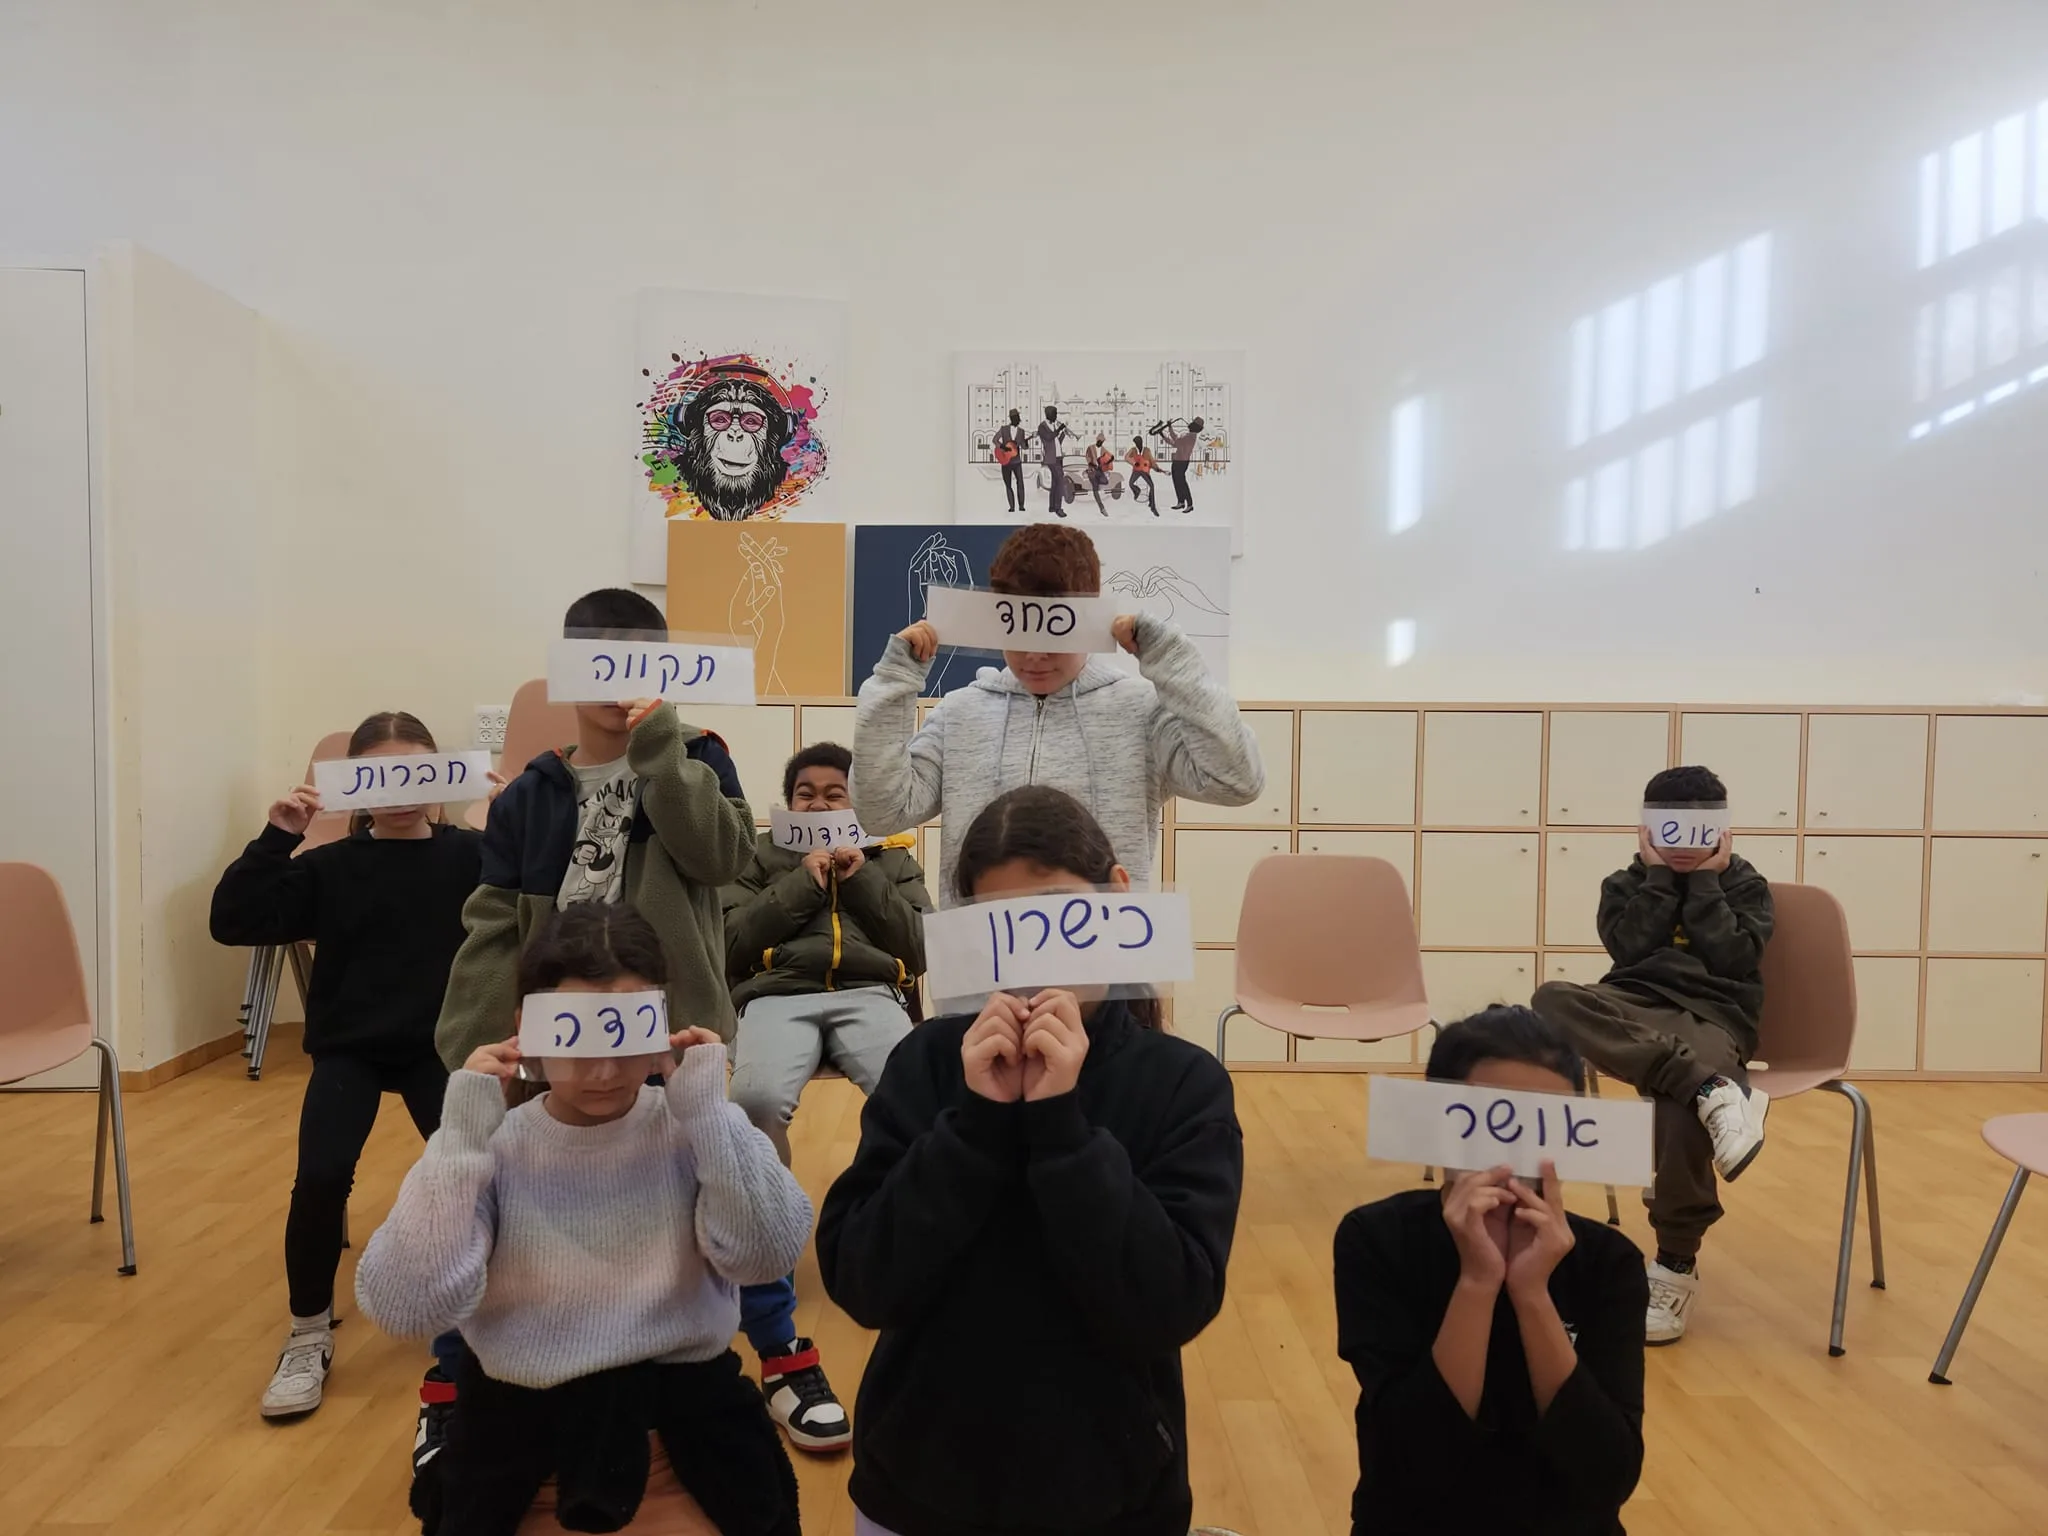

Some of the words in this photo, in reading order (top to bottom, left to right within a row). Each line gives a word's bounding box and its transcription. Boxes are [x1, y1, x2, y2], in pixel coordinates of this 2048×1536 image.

[995, 600, 1077, 637] פחד
[592, 653, 716, 694] תקווה
[342, 760, 467, 796] חברות
[988, 898, 1154, 983] כישרון
[1445, 1098, 1600, 1148] אושר
